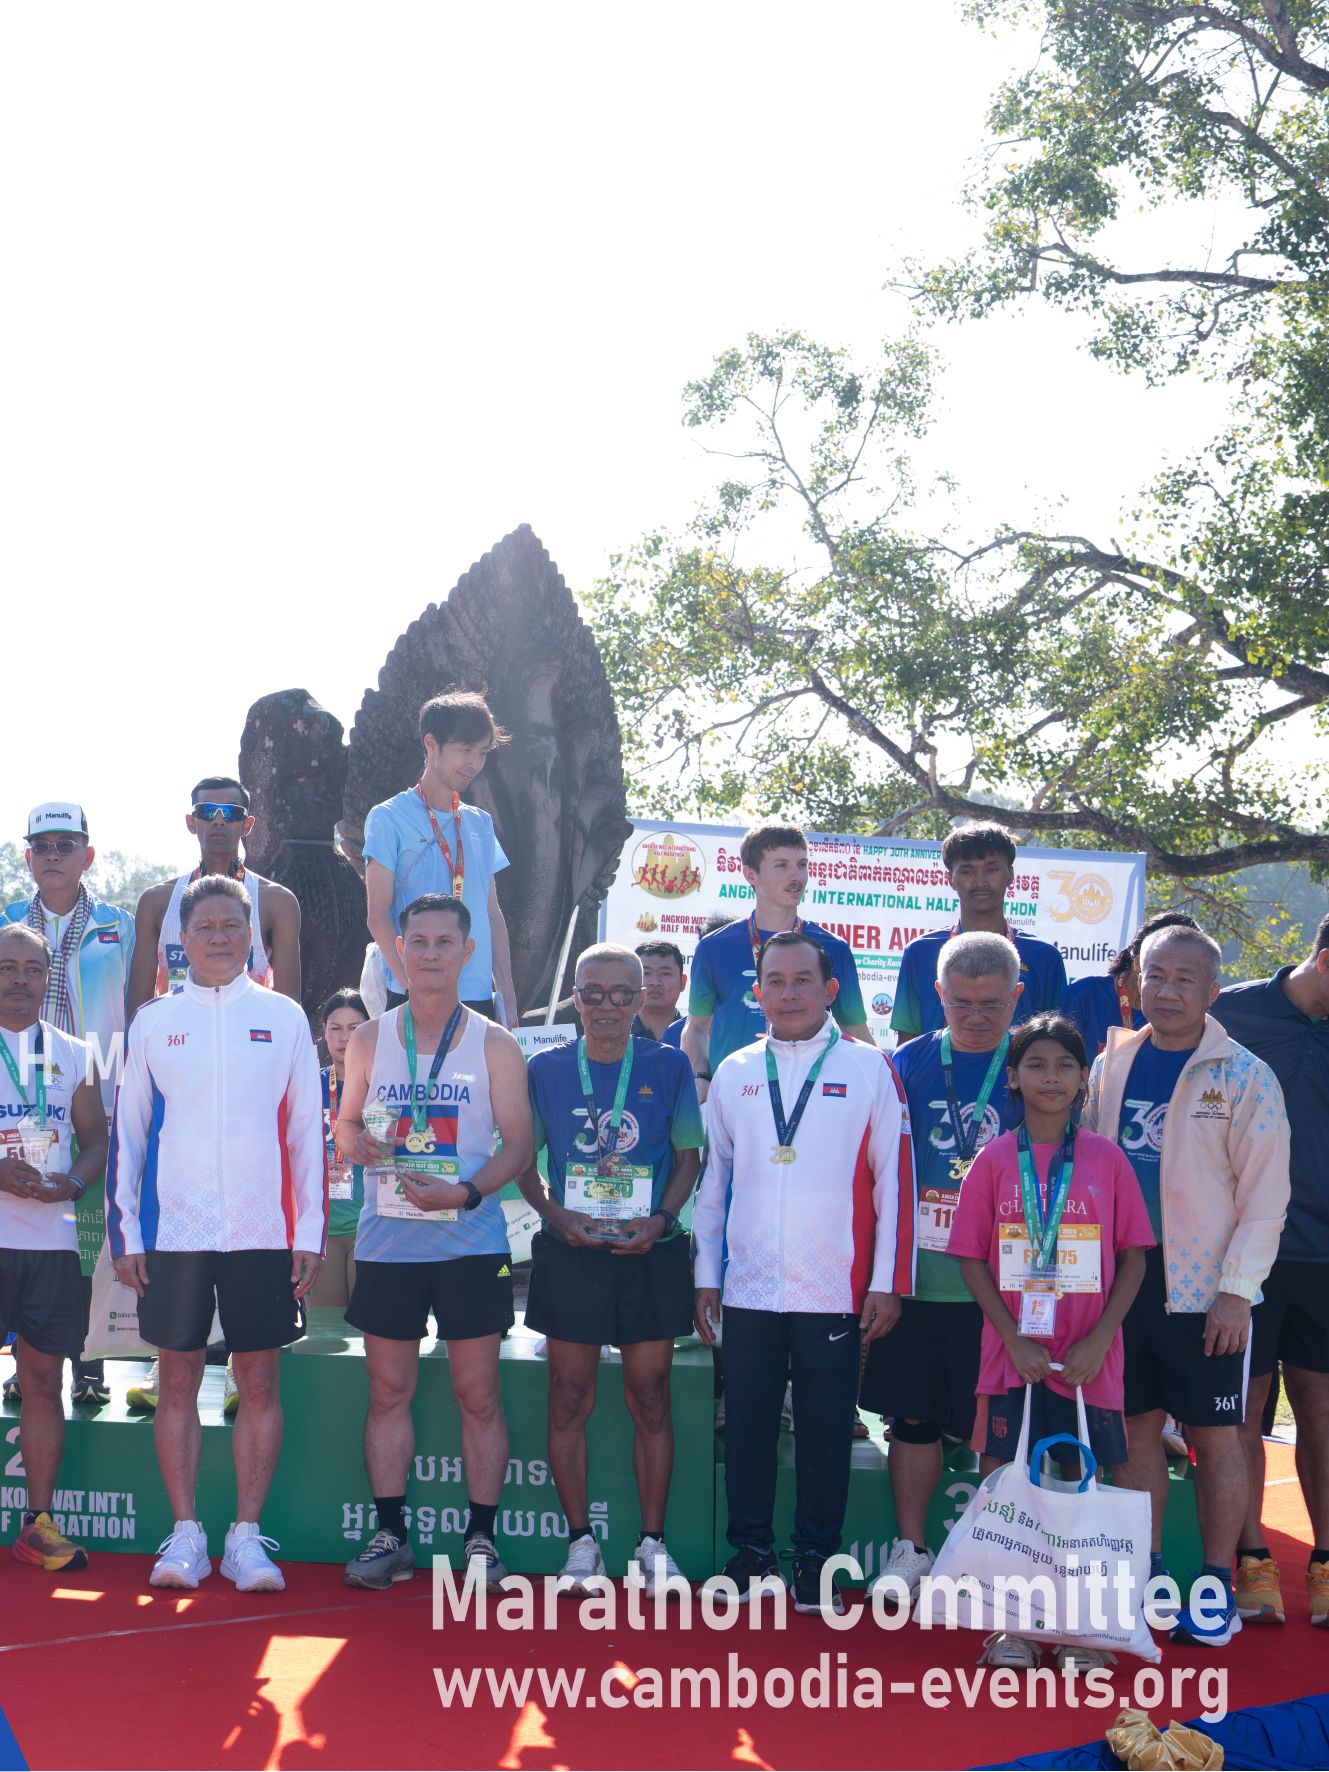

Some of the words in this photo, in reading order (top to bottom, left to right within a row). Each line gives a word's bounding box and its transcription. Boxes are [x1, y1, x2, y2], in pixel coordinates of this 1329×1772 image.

[863, 845, 886, 857] HAPPY
[890, 847, 909, 858] 30TH
[812, 890, 922, 910] INTERNATIONAL
[925, 897, 960, 912] HALF
[1055, 942, 1117, 963] anulife
[533, 1034, 568, 1045] Manulife
[377, 1083, 471, 1104] CAMBODIA
[933, 1207, 956, 1229] 11
[57, 1512, 136, 1540] RATHON
